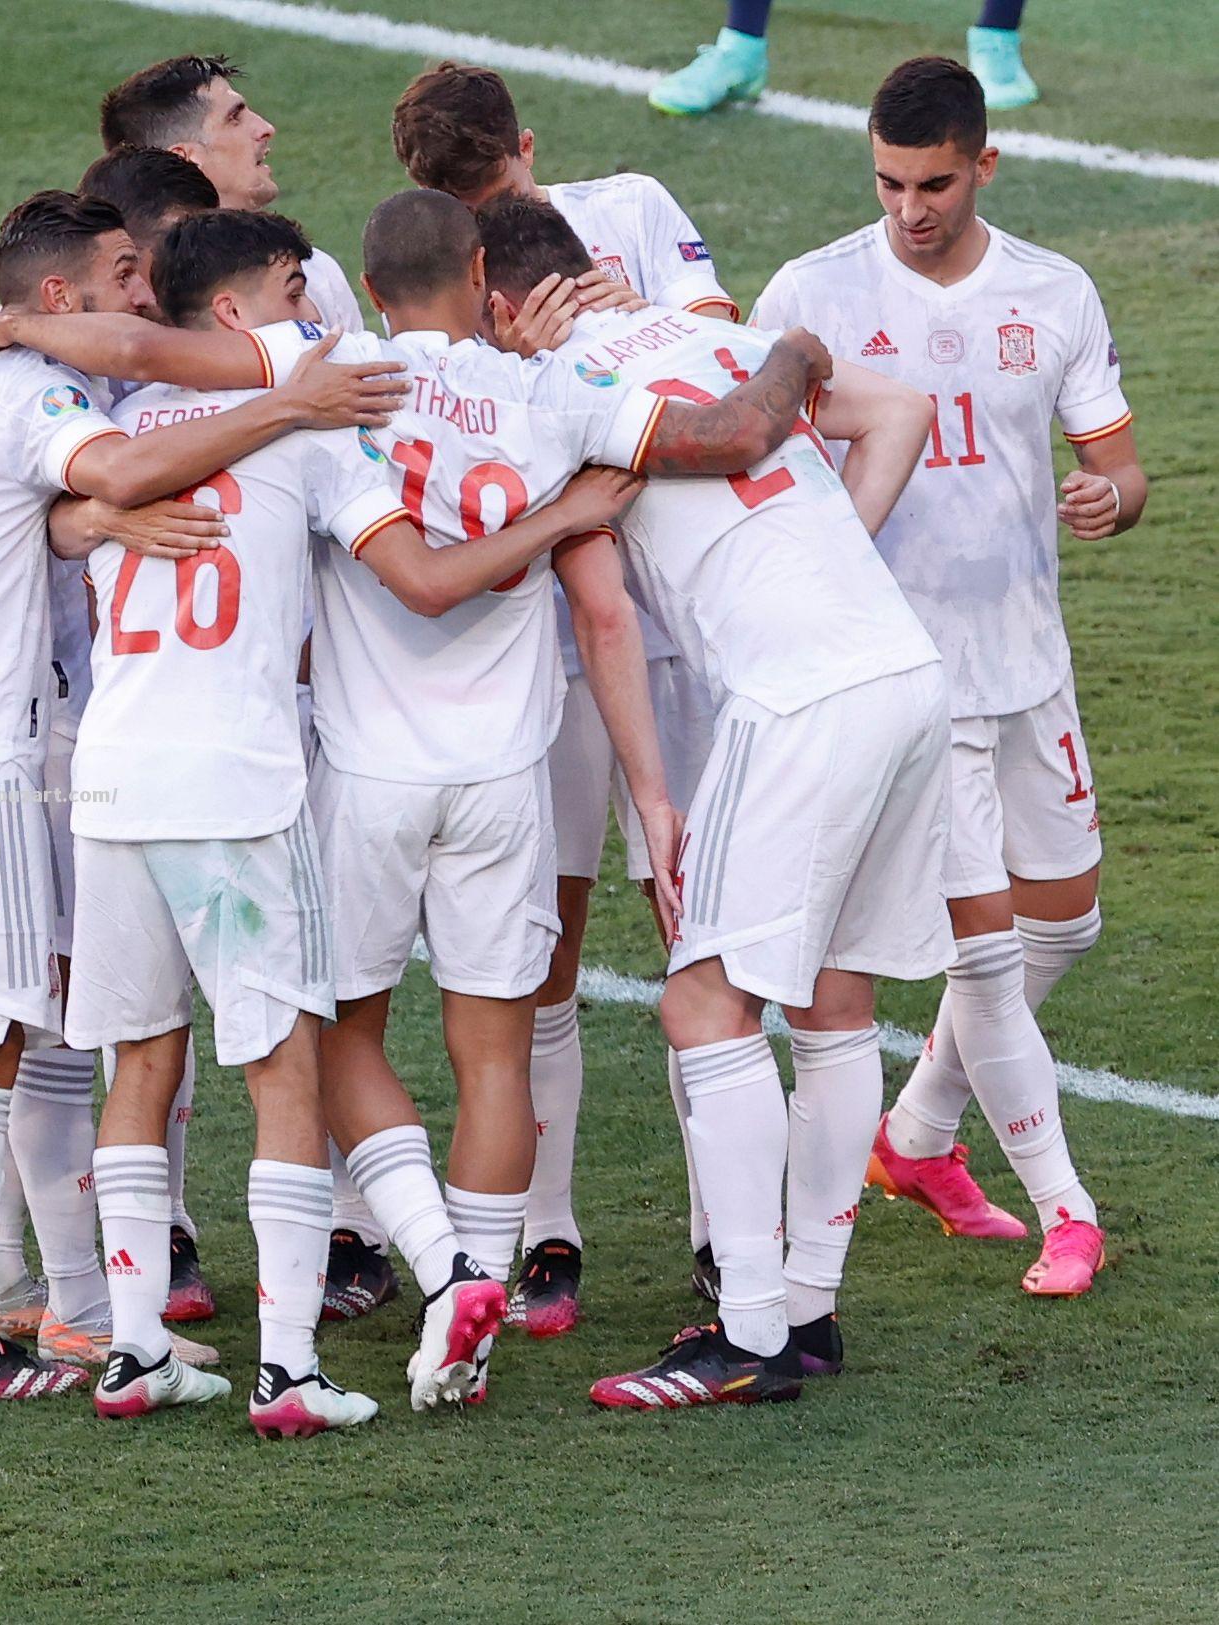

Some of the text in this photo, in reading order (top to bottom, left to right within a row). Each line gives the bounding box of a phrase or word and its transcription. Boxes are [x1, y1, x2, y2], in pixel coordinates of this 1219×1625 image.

[585, 315, 698, 370] LAPORTE
[861, 345, 899, 356] adidas
[925, 392, 985, 469] 11
[1007, 1107, 1046, 1136] RFEF
